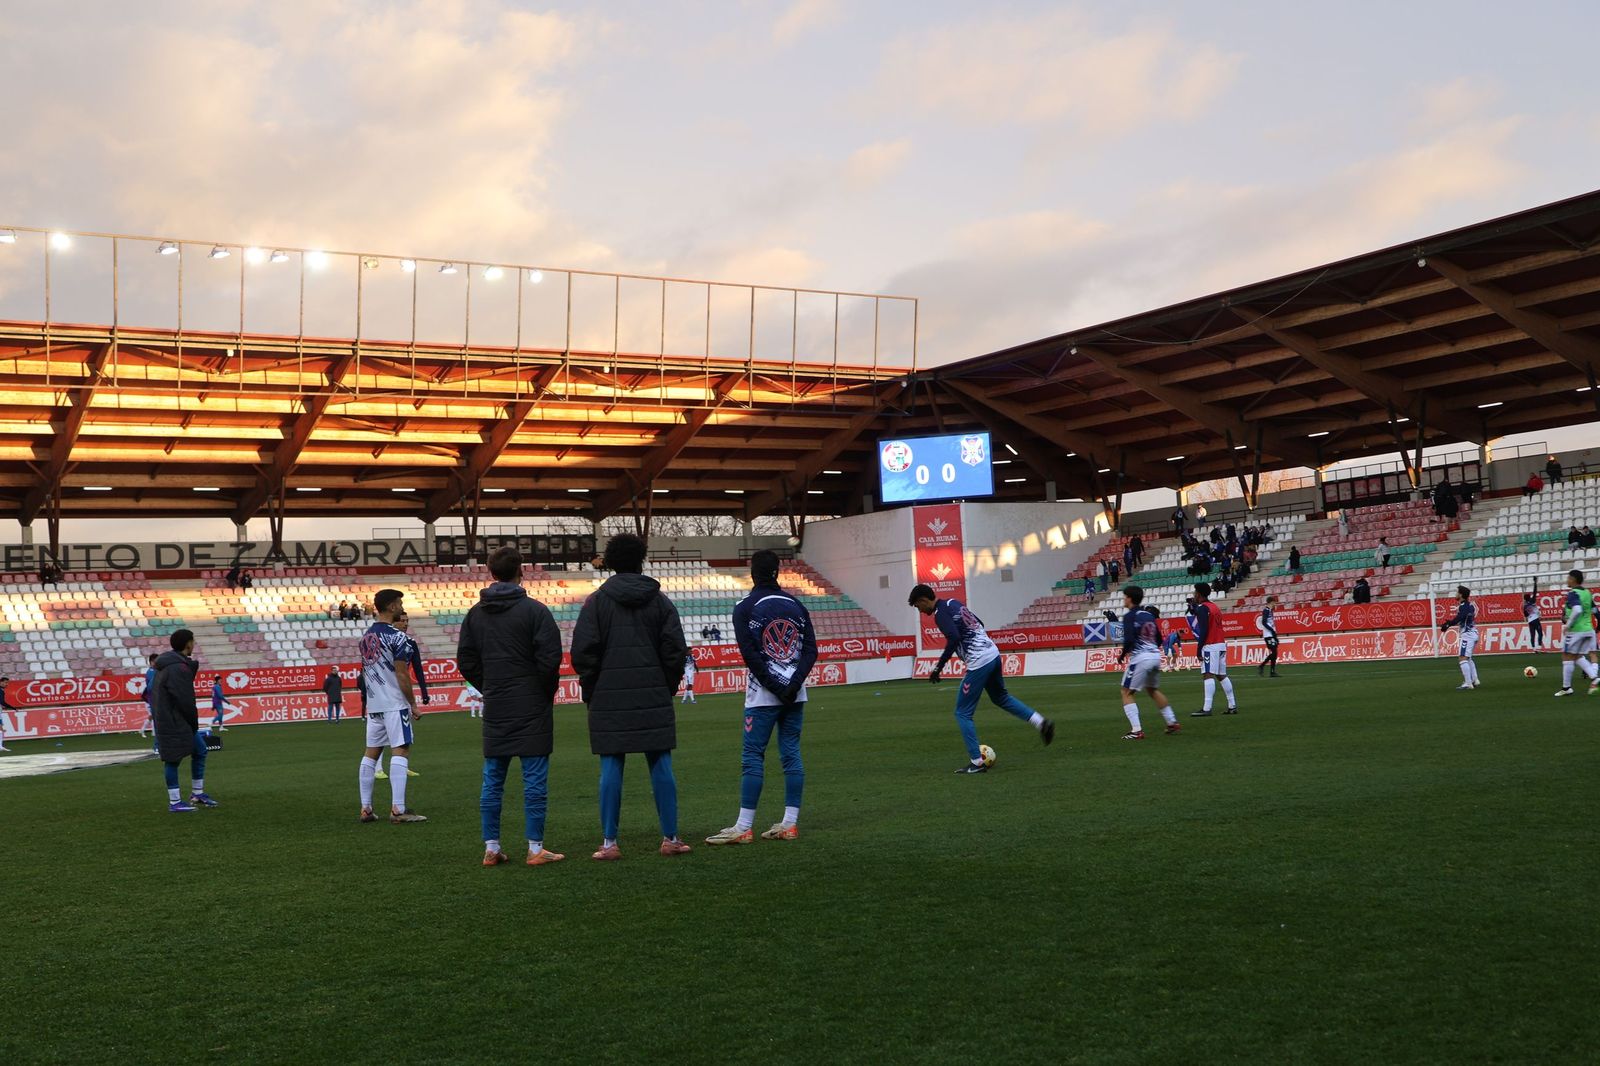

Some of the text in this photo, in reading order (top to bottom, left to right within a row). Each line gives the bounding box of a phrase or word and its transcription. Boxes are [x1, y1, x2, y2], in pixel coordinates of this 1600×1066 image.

[916, 463, 955, 485] 0 0
[155, 543, 215, 569] DE
[229, 541, 423, 567] ZAMORA
[1042, 633, 1050, 641] DÍA
[1058, 632, 1082, 640] ZAMORA
[1350, 636, 1385, 646] CLÍNICA
[866, 639, 914, 654] Melquiades
[1106, 648, 1123, 657] OND
[1313, 636, 1347, 660] Ápex
[1350, 645, 1384, 656] DENTAL
[691, 648, 715, 660] ORA
[250, 668, 315, 676] ORTOPEDIA
[250, 675, 316, 685] tres cruces
[711, 672, 724, 688] La
[26, 677, 110, 697] CarDiZa
[26, 695, 69, 703] EMBUTIDOS
[77, 692, 111, 700] JAMONES
[259, 695, 346, 707] CLÍNICA DENL
[59, 705, 124, 721] TERNERA
[260, 706, 288, 721] JOSÉ
[292, 707, 308, 719] DE
